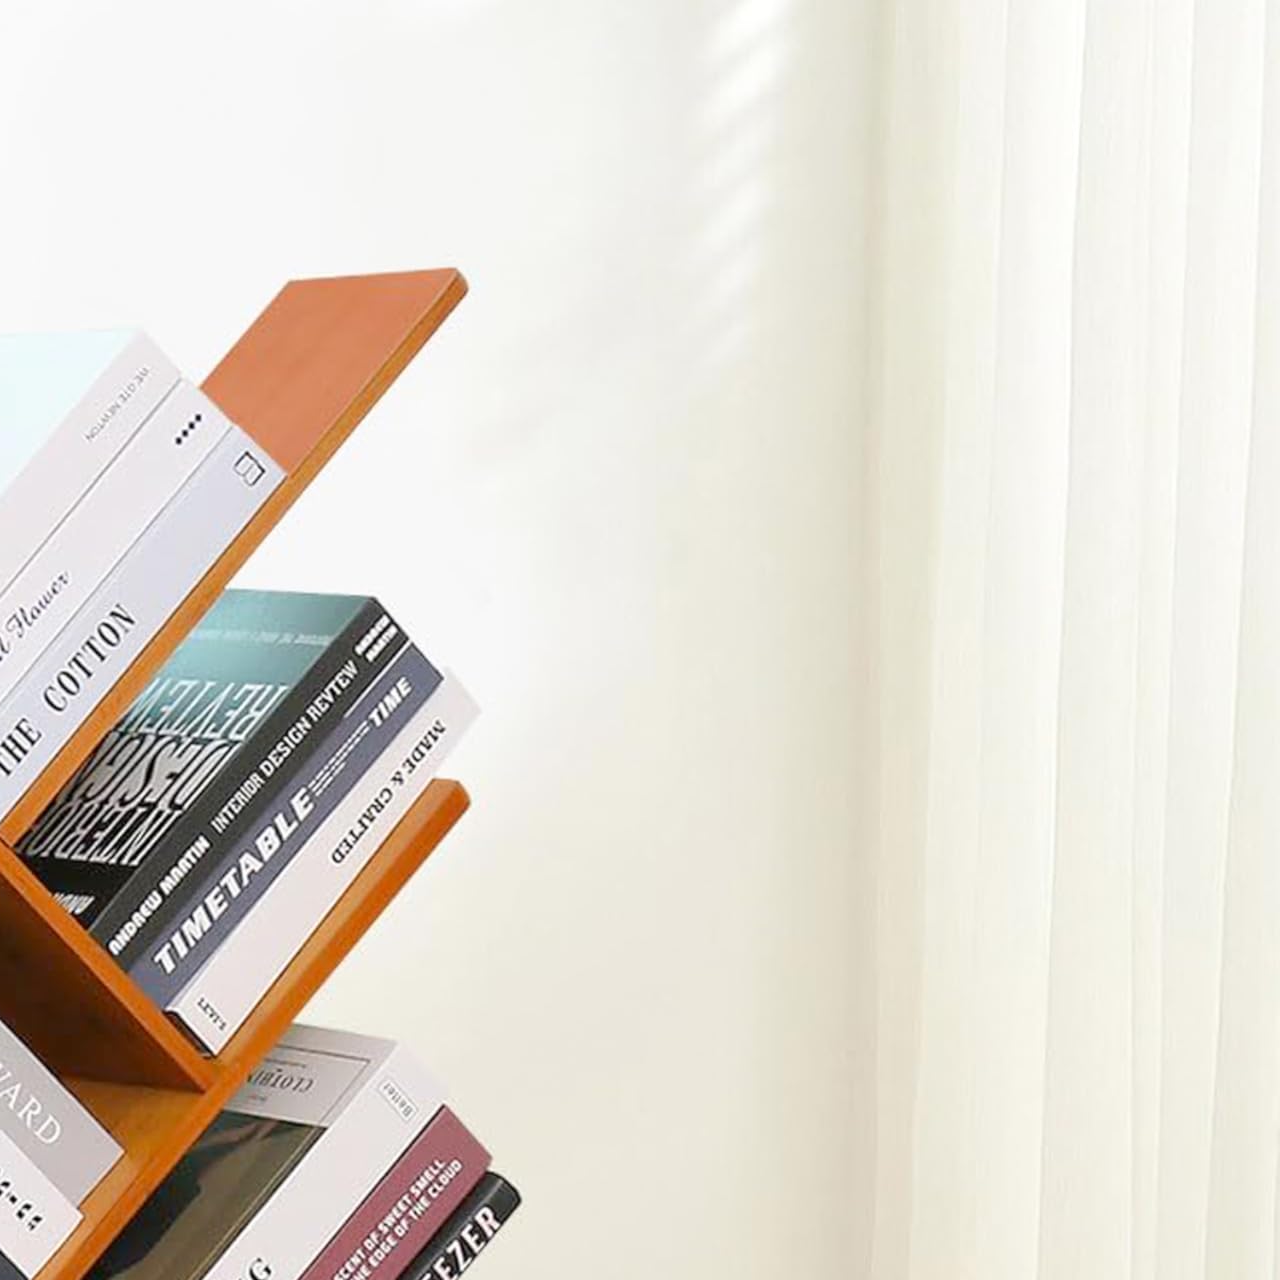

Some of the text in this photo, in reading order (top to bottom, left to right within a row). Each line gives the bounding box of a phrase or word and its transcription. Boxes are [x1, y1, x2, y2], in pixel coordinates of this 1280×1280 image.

[5, 571, 71, 644] Flower
[43, 604, 138, 713] COTTON
[390, 768, 407, 787] &
[403, 719, 447, 766] MADE
[107, 893, 162, 956] ANDREW
[159, 836, 211, 895] MARTIN
[210, 774, 263, 834] INTERIOR
[258, 718, 312, 783] DESIGN
[153, 786, 316, 975] TIMETABLE
[368, 676, 413, 728] TIME
[330, 786, 396, 866] CRAFTED
[362, 1231, 380, 1250] OF
[376, 1195, 413, 1234] SWEET
[408, 1157, 446, 1196] SMELL
[366, 1234, 397, 1266] EDGE
[393, 1218, 411, 1236] OF
[407, 1196, 430, 1219] THE
[425, 1159, 463, 1198] CLOUD
